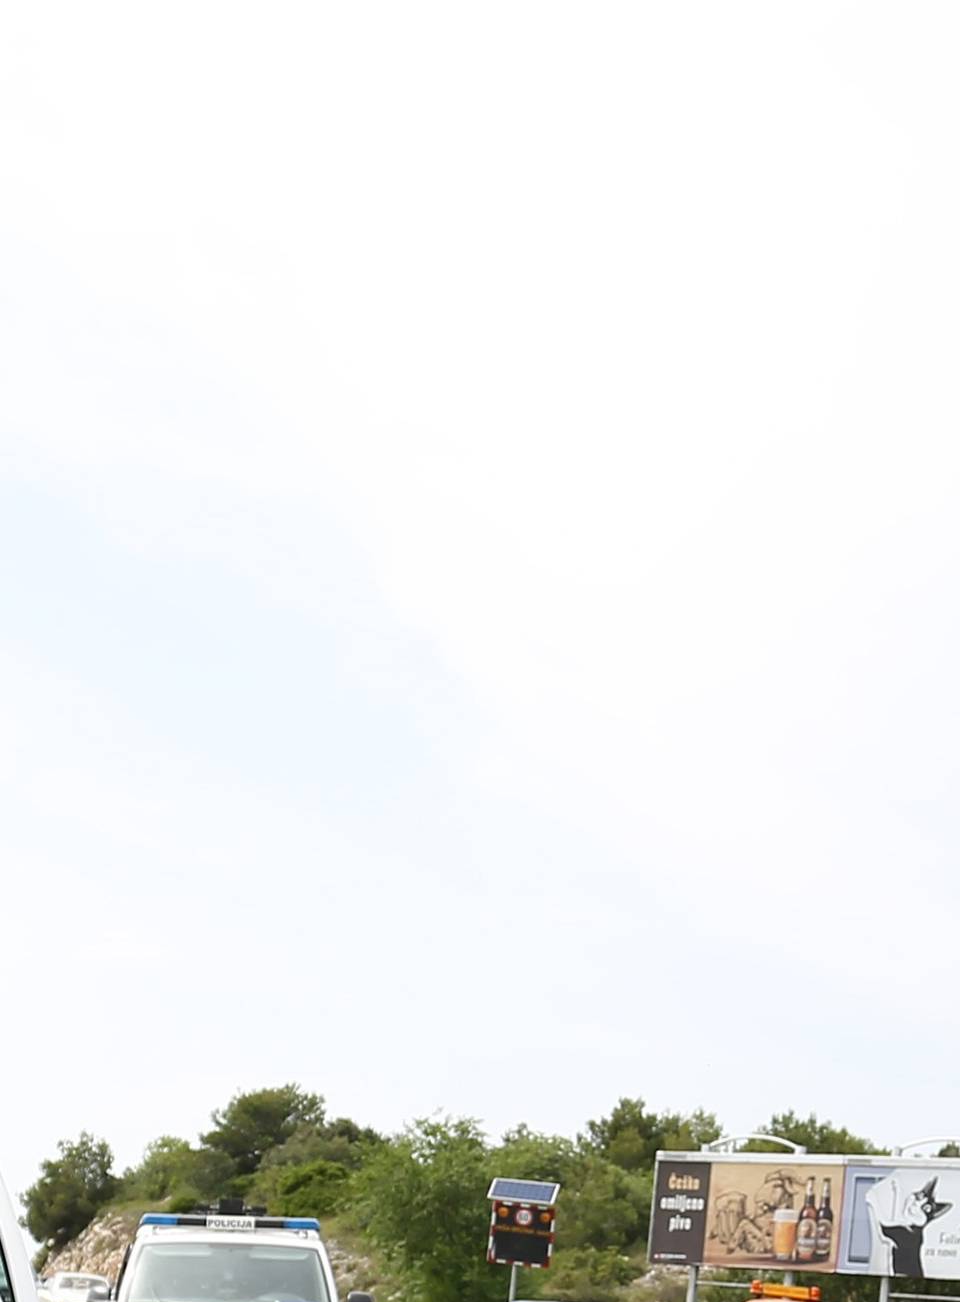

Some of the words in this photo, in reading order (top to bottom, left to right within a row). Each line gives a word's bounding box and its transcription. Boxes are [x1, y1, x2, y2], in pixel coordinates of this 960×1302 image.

[207, 1219, 253, 1228] POLICIJA
[668, 1214, 692, 1232] pivo
[939, 1232, 960, 1245] Felix
[925, 1248, 935, 1257] za
